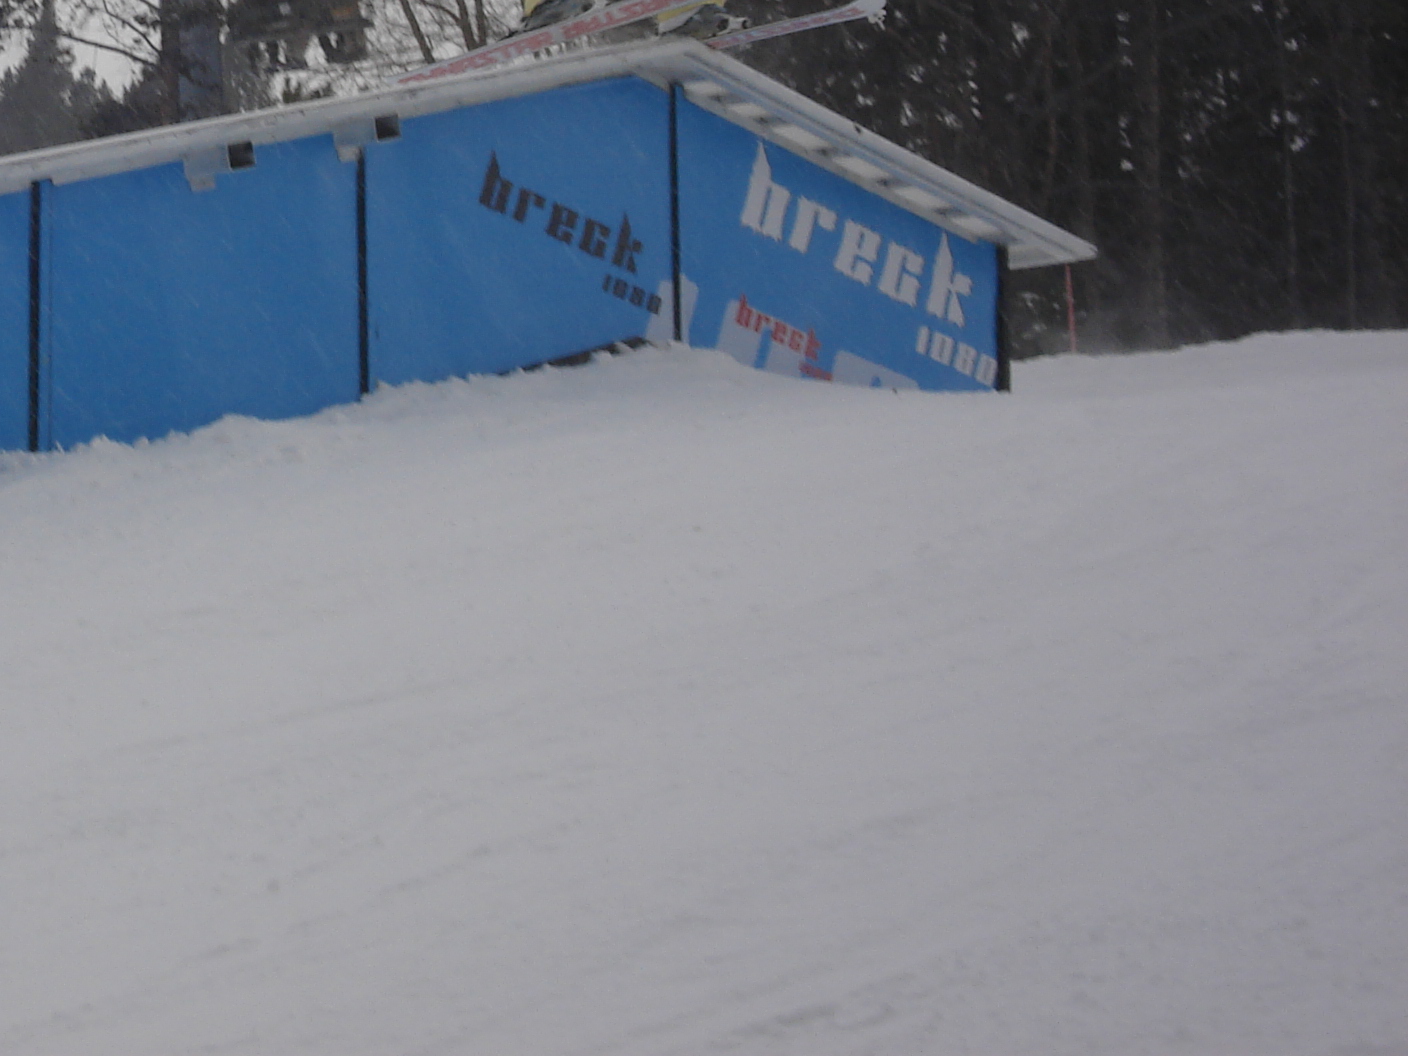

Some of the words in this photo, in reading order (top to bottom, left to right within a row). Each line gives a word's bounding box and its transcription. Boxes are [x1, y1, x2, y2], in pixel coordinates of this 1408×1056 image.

[479, 150, 643, 275] breck
[740, 139, 973, 328] breck
[915, 325, 999, 387] 1080
